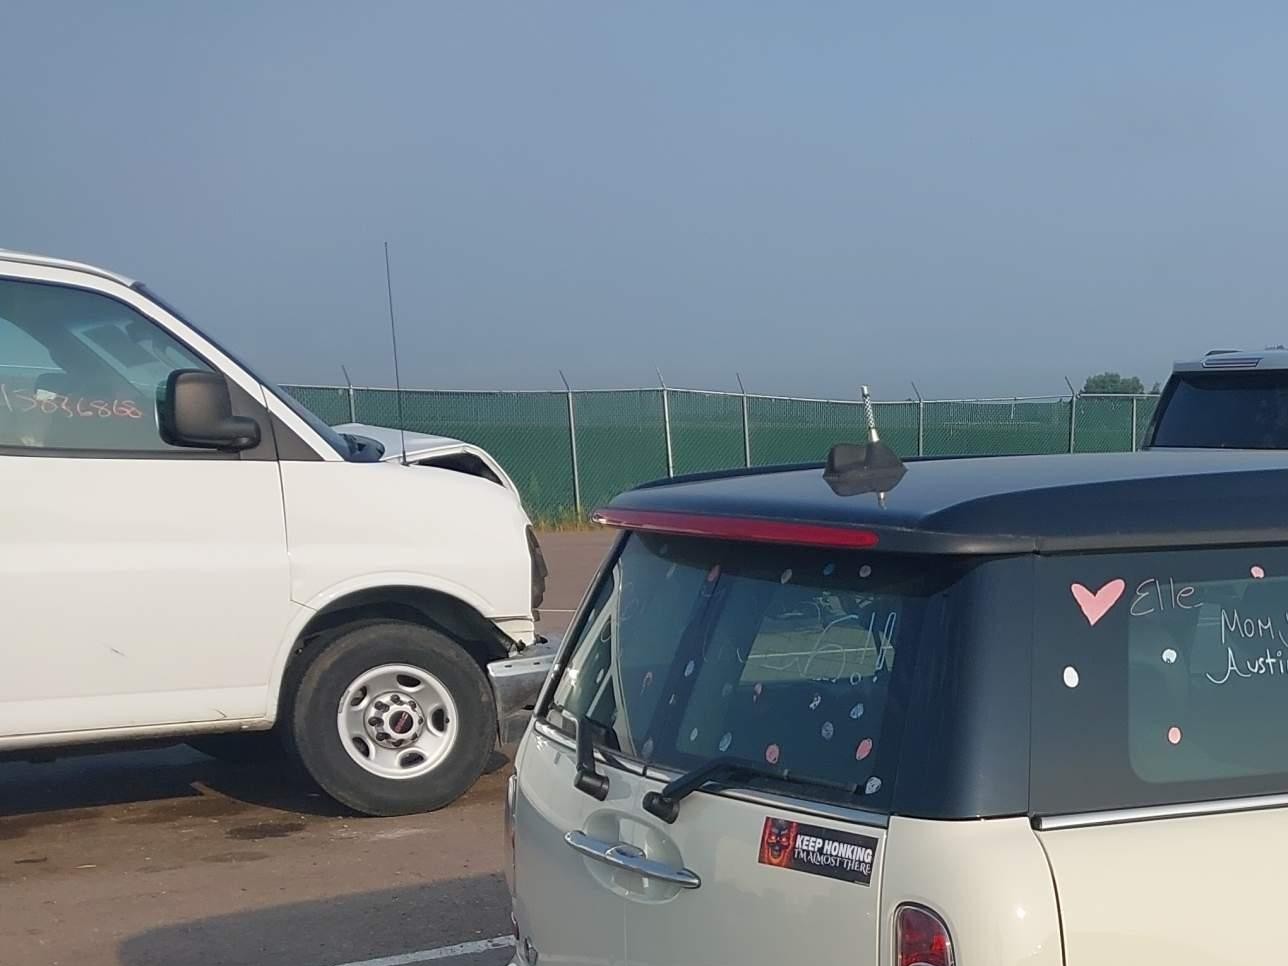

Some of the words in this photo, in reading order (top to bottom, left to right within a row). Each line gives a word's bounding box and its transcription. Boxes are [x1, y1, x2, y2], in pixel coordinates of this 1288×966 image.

[1130, 577, 1203, 616] Elle
[795, 834, 822, 852] KEEP
[823, 839, 872, 863] HONKING
[807, 851, 841, 867] ALMOST
[840, 857, 871, 875] THERE
